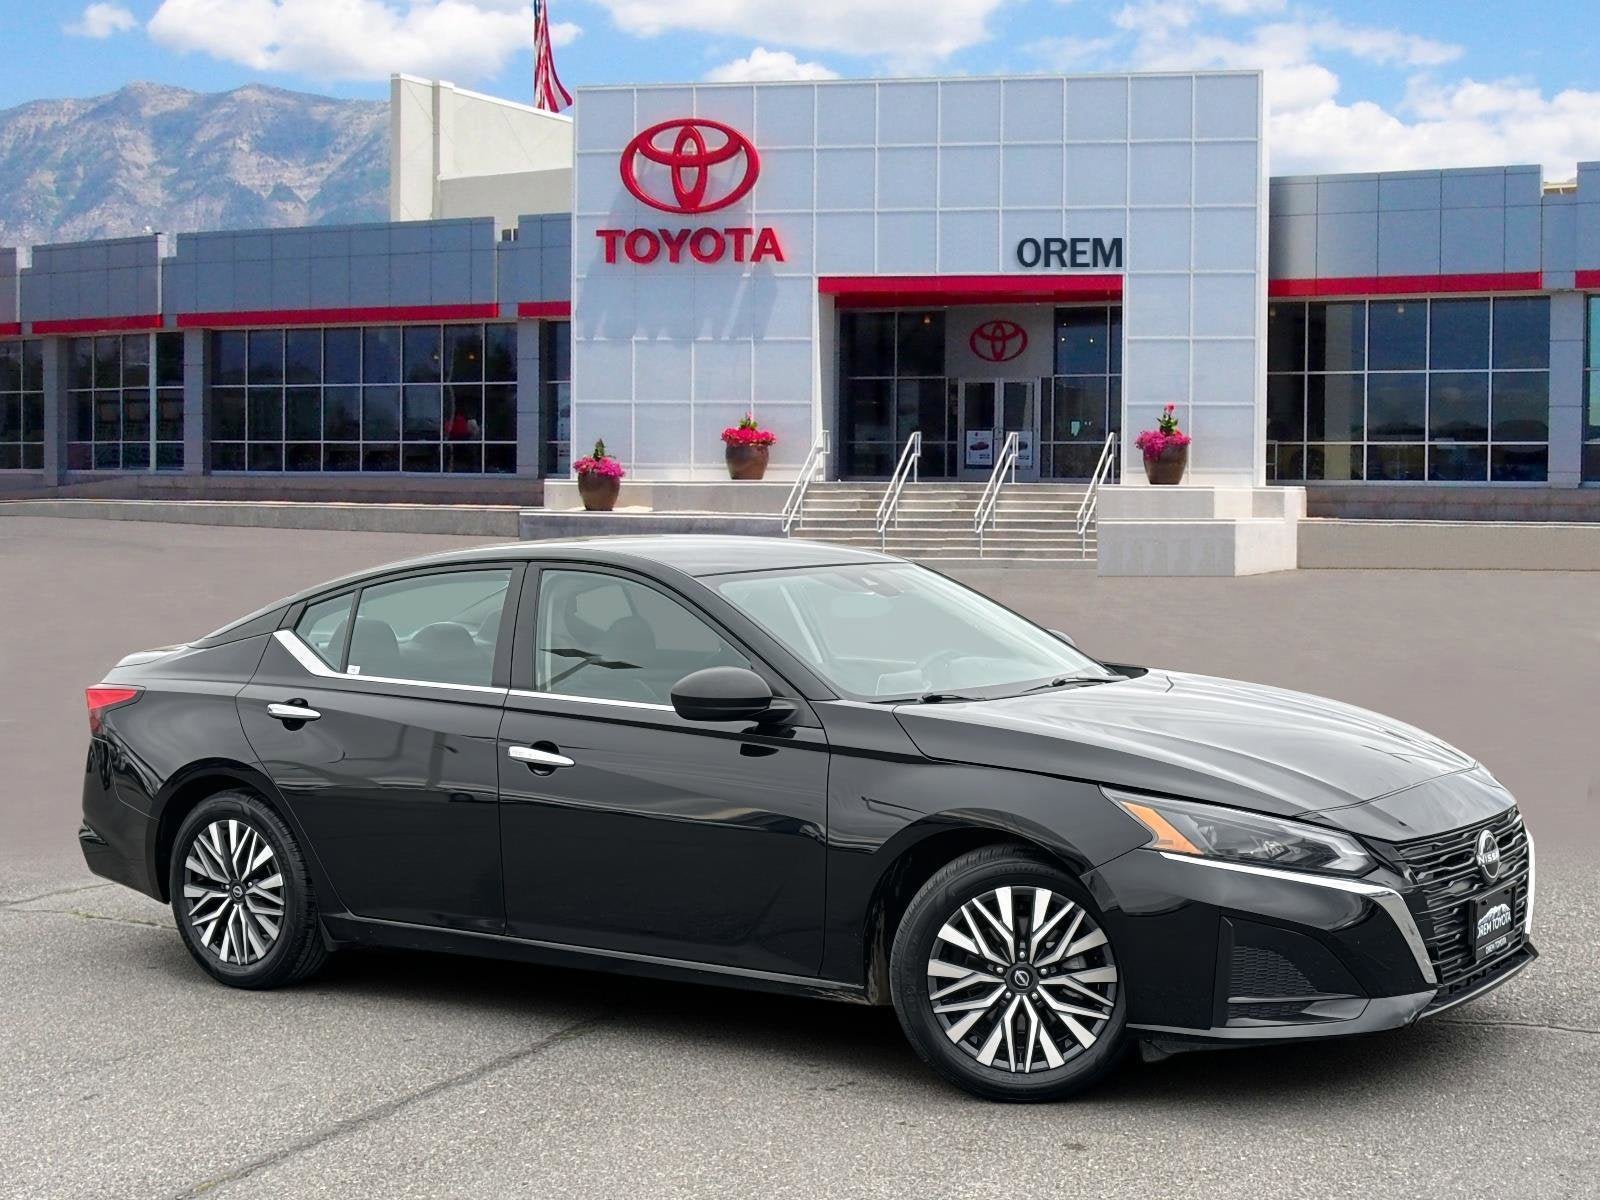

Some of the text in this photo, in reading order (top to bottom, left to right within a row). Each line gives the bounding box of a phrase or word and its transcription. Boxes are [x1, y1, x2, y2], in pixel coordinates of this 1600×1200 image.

[596, 227, 785, 264] TOYOTA
[1016, 237, 1123, 268] OREM
[1477, 849, 1499, 866] NISS
[1492, 910, 1512, 931] TOYOTA
